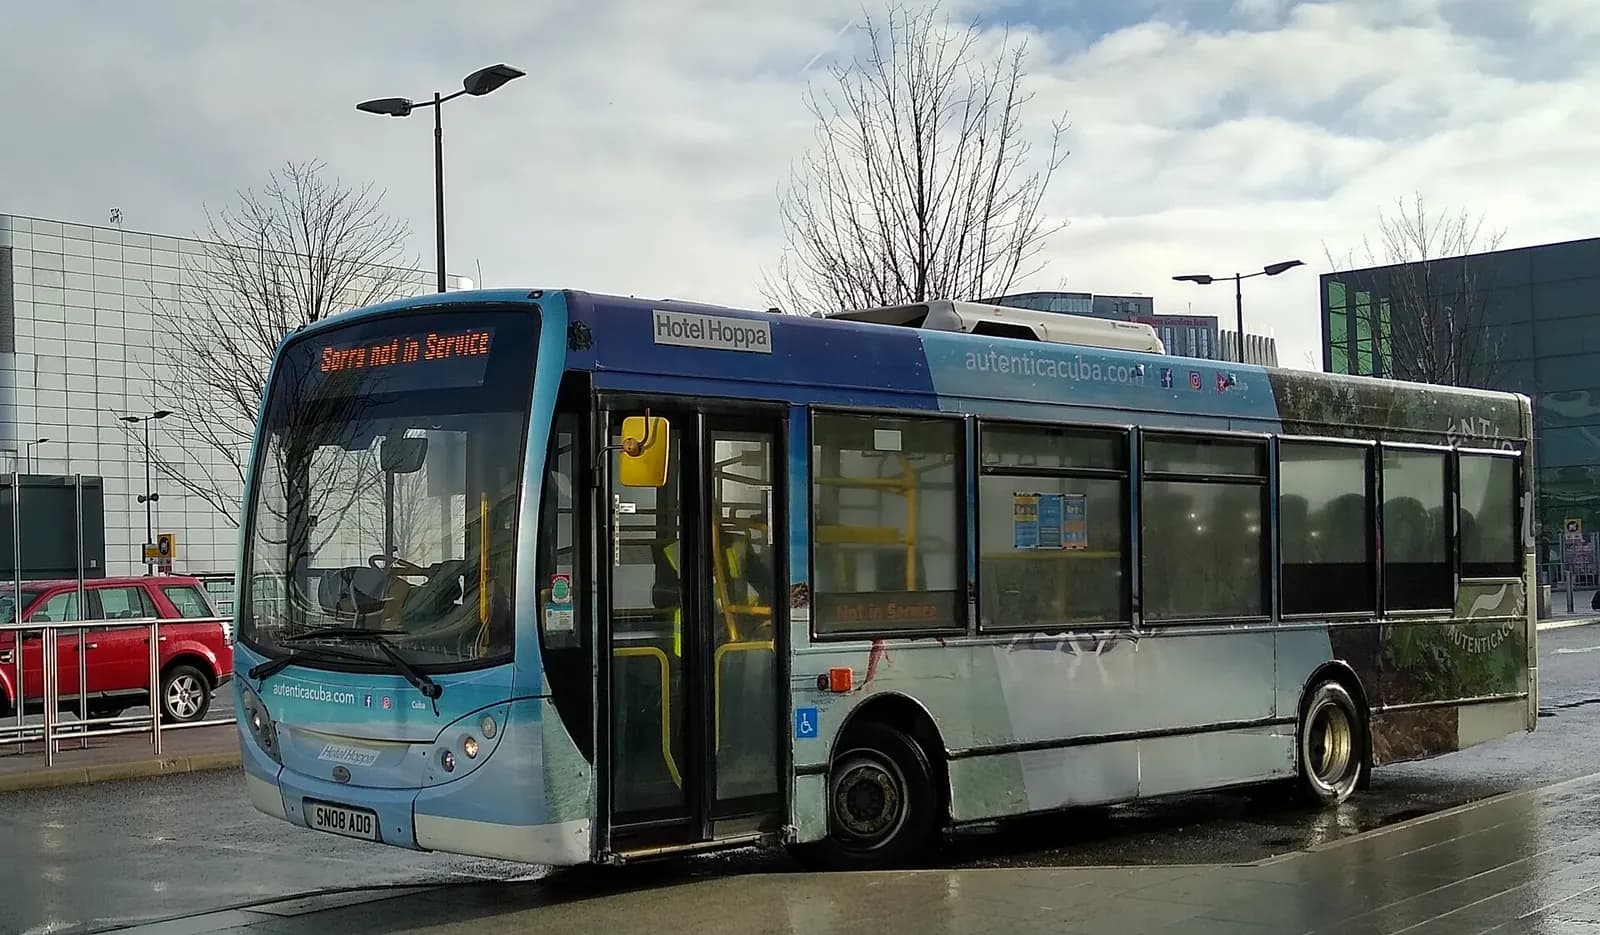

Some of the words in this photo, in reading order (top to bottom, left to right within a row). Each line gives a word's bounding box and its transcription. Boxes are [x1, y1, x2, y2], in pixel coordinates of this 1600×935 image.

[656, 314, 705, 340] Hotel
[708, 319, 767, 348] Hoppa
[320, 346, 366, 372] Sorry
[370, 338, 399, 367] not
[402, 337, 420, 363] in
[424, 329, 489, 360] Service
[965, 351, 1145, 385] autenticacuba.com
[273, 682, 355, 705] autenticacuba.com
[321, 745, 347, 760] Hotel
[316, 807, 346, 830] SN08
[348, 812, 371, 834] ADO
